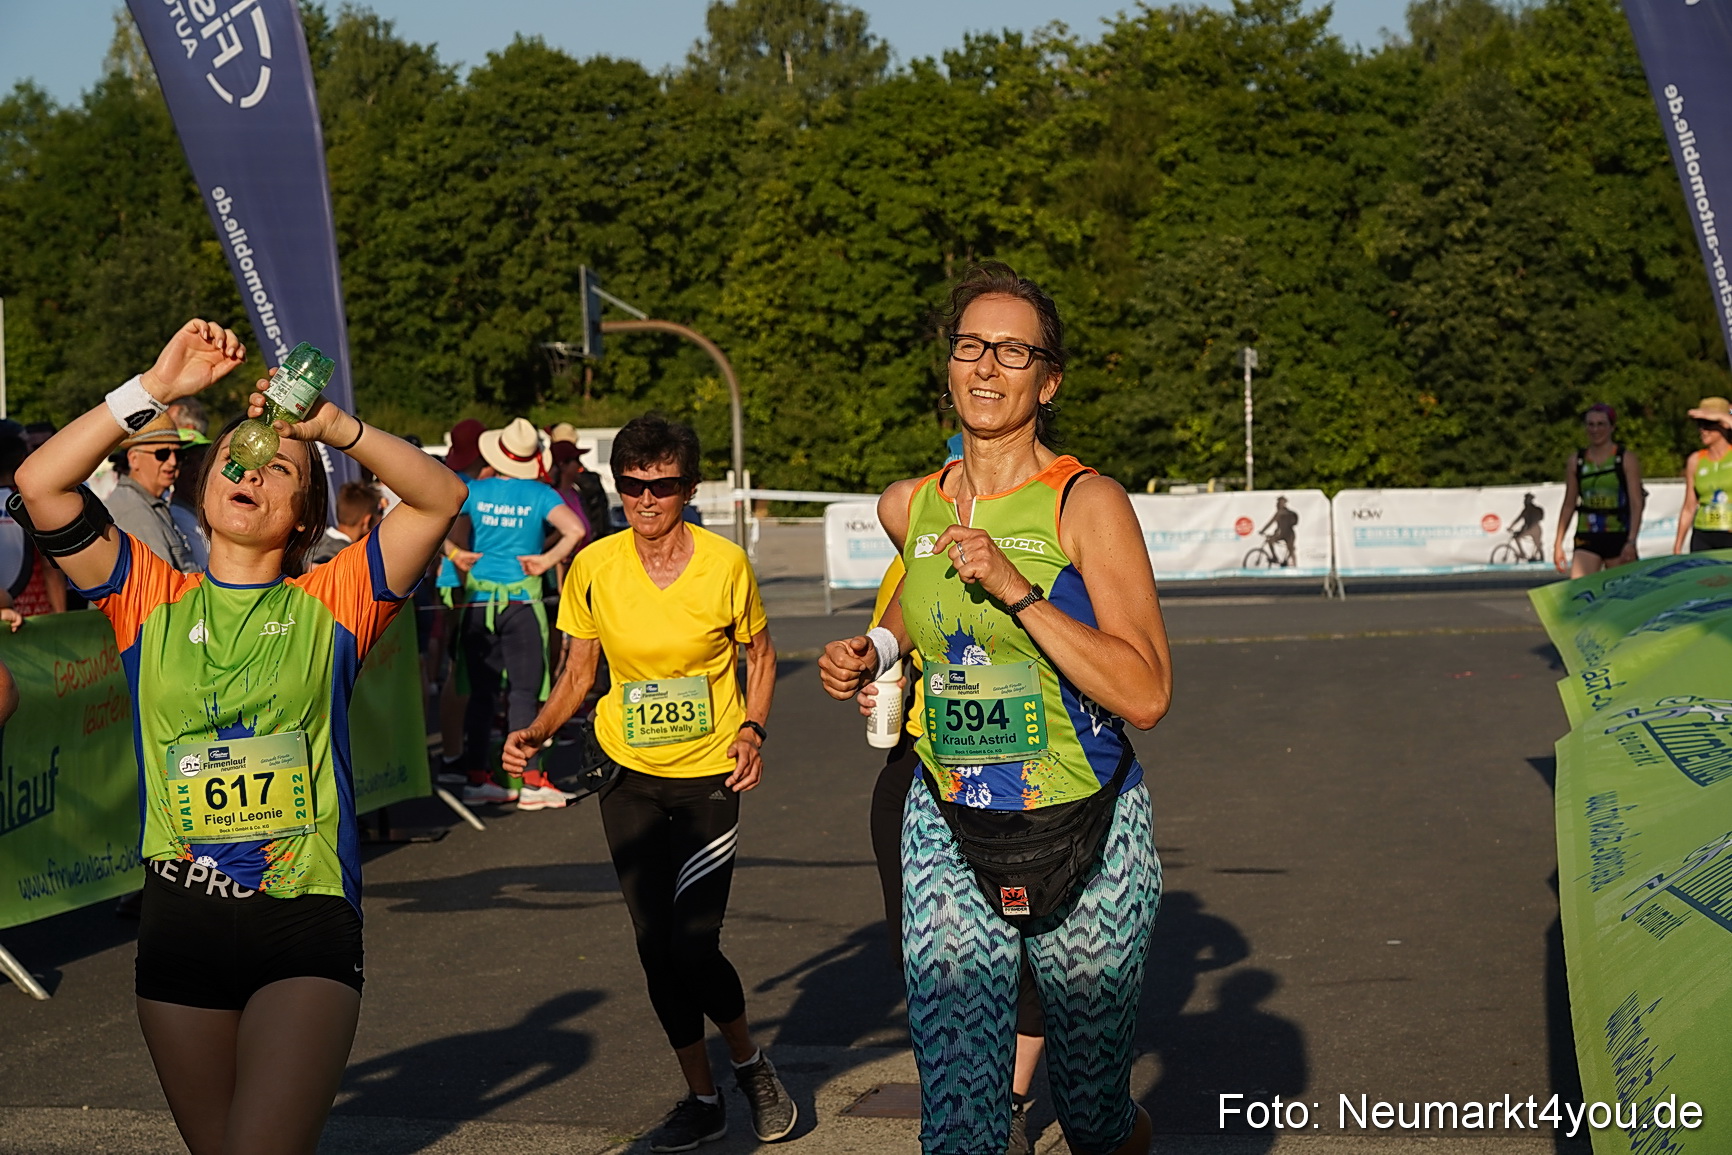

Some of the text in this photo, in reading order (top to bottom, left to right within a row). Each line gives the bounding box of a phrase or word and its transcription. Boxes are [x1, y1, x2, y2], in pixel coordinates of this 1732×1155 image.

[944, 682, 980, 691] Firmenlauf
[627, 707, 635, 740] WALK
[636, 700, 696, 725] 1283
[698, 702, 708, 732] 2022
[928, 708, 937, 742] RUN
[945, 698, 1010, 732] 594
[1023, 700, 1040, 746] 2022
[669, 724, 693, 733] Wally
[942, 732, 1017, 746] Krauß Astrid
[203, 756, 247, 770] Firmenlauf
[205, 772, 275, 811] 617
[292, 773, 307, 819] 2022
[177, 784, 194, 832] WALK
[204, 808, 283, 827] Fiegl Leonie
